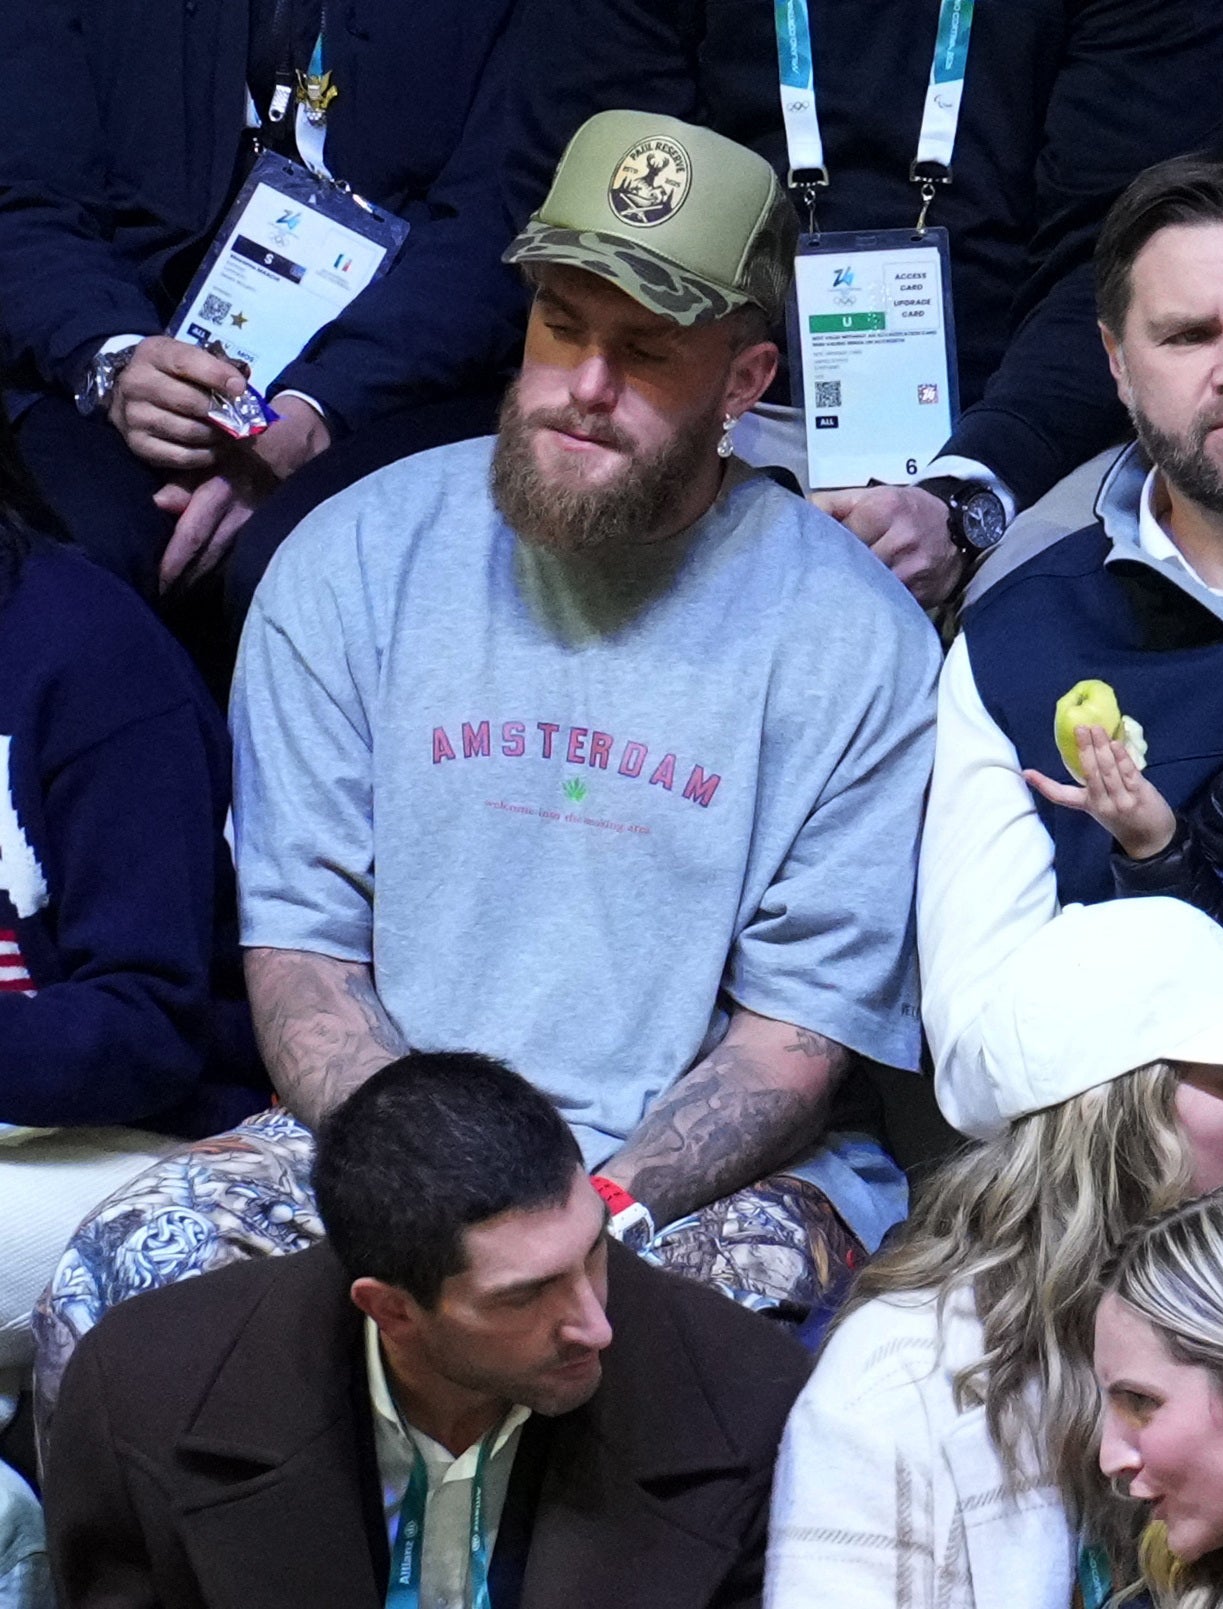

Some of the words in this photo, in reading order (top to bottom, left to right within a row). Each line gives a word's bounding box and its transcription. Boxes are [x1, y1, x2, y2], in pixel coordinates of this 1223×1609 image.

[630, 142, 652, 161] PAUL
[655, 142, 686, 174] RESERVE
[263, 253, 274, 265] S
[894, 272, 927, 280] ACCESS
[894, 298, 931, 307] UPGRADE
[901, 310, 925, 318] CARD
[842, 316, 853, 328] U
[820, 418, 835, 426] ALL
[905, 458, 918, 475] 6
[432, 720, 721, 808] AMSTERDAM
[399, 1540, 415, 1585] Allianz
